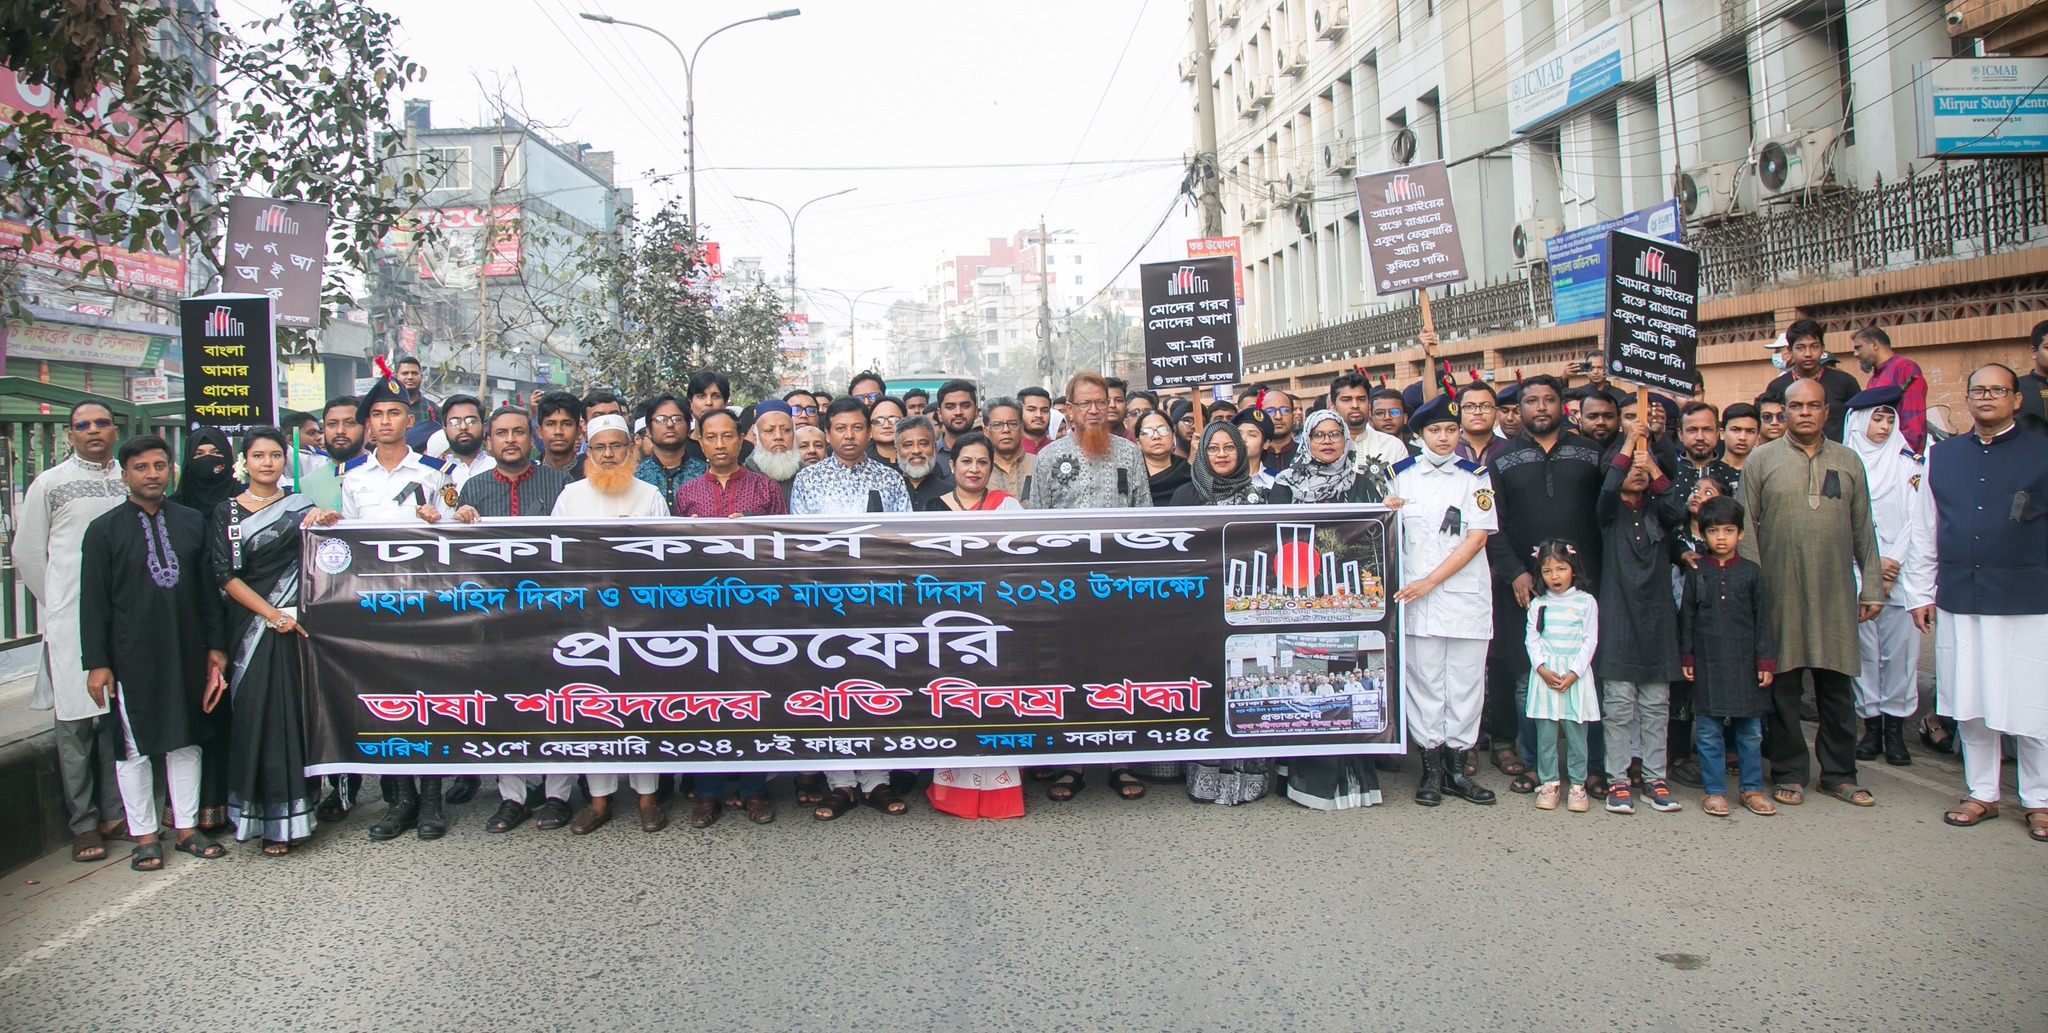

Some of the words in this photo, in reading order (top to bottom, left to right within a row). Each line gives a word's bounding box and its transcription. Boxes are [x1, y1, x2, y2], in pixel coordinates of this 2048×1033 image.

[1522, 56, 1564, 97] ICMAB
[1982, 65, 2018, 76] ICMAB
[1939, 97, 1979, 114] Mirpur
[1981, 97, 2013, 113] Study
[1370, 206, 1402, 218] আমার
[1404, 198, 1444, 213] ভাইয়ের
[1378, 220, 1402, 232] রক্তে
[1404, 213, 1441, 227] রাঙানো
[1658, 213, 1673, 225] BUBT
[1373, 233, 1405, 247] একুশে
[1407, 223, 1453, 240] ফেব্রুয়ারি
[234, 242, 253, 259] খ
[263, 242, 279, 256] গ
[289, 254, 315, 272] আ
[1394, 243, 1419, 255] আমি
[1420, 241, 1436, 252] কি
[235, 266, 260, 282] অ
[270, 262, 285, 279] ই
[1386, 259, 1420, 274] ভুলিতে
[1393, 278, 1410, 287] ঢাকা
[1412, 272, 1434, 284] কমার্স
[1435, 269, 1459, 279] কলেজ
[1615, 275, 1650, 293] আমার
[1652, 284, 1694, 304] ভাইয়ের
[1149, 302, 1195, 315] মোদের
[1199, 299, 1230, 311] গরব
[1622, 293, 1646, 308] রক্তে
[1648, 300, 1688, 320] রাঙানো
[1148, 316, 1194, 330] মোদের
[1197, 312, 1232, 325] আশা
[1613, 308, 1645, 326] একুশে
[1648, 318, 1697, 338] ফেব্রুয়ারি
[1166, 336, 1216, 352] আ-মরি
[1632, 329, 1658, 345] আমি
[1660, 335, 1676, 349] কি
[24, 345, 65, 354] LIBRARY
[79, 350, 142, 362] STATIONERY
[203, 345, 245, 358] বাংলা
[1621, 343, 1656, 360] ভুলিতে
[1151, 355, 1188, 368] বাংলা
[202, 365, 249, 377] আমার
[1185, 372, 1208, 383] কমার্স
[1209, 373, 1234, 381] কলেজ
[1624, 365, 1642, 377] ঢাকা
[1644, 370, 1666, 383] কমার্স
[1668, 377, 1693, 390] কলেজ
[203, 384, 250, 397] প্রাণের
[359, 534, 582, 566] ঢাকা
[599, 524, 882, 562] কমার্স
[898, 527, 1206, 557] কলেজ
[356, 587, 429, 615] মহান
[434, 580, 510, 615] শহিদ
[515, 580, 588, 611] দিবস
[597, 587, 620, 608] ও
[628, 576, 783, 609] আন্তর্জাতিক
[788, 580, 907, 616] মাতৃভাষা
[913, 574, 987, 605] দিবস
[996, 576, 1077, 605] ২০২৪
[1087, 571, 1210, 601] উপলক্ষ্যে
[553, 610, 1014, 676] প্রভাতফেরি
[357, 690, 498, 726] ভাষা
[504, 683, 771, 728] শহিদদের
[784, 679, 913, 722] প্রতি
[919, 677, 1075, 719] বিনম্র
[1082, 677, 1213, 715] শ্রদ্ধা
[1260, 710, 1322, 721] প্রভাতফেরি
[355, 737, 432, 757] তারিখ
[462, 740, 531, 758] ২১শে
[539, 735, 650, 758] ফেব্রুয়ারি
[659, 738, 744, 757] ২০২৪,
[754, 733, 796, 755] ৮ই
[802, 735, 874, 756] ফাল্গুন
[884, 736, 957, 752] ১৪৩০
[976, 732, 1037, 749] সময়
[1063, 729, 1137, 746] সকাল
[1147, 728, 1213, 744] ৭:৪৫
